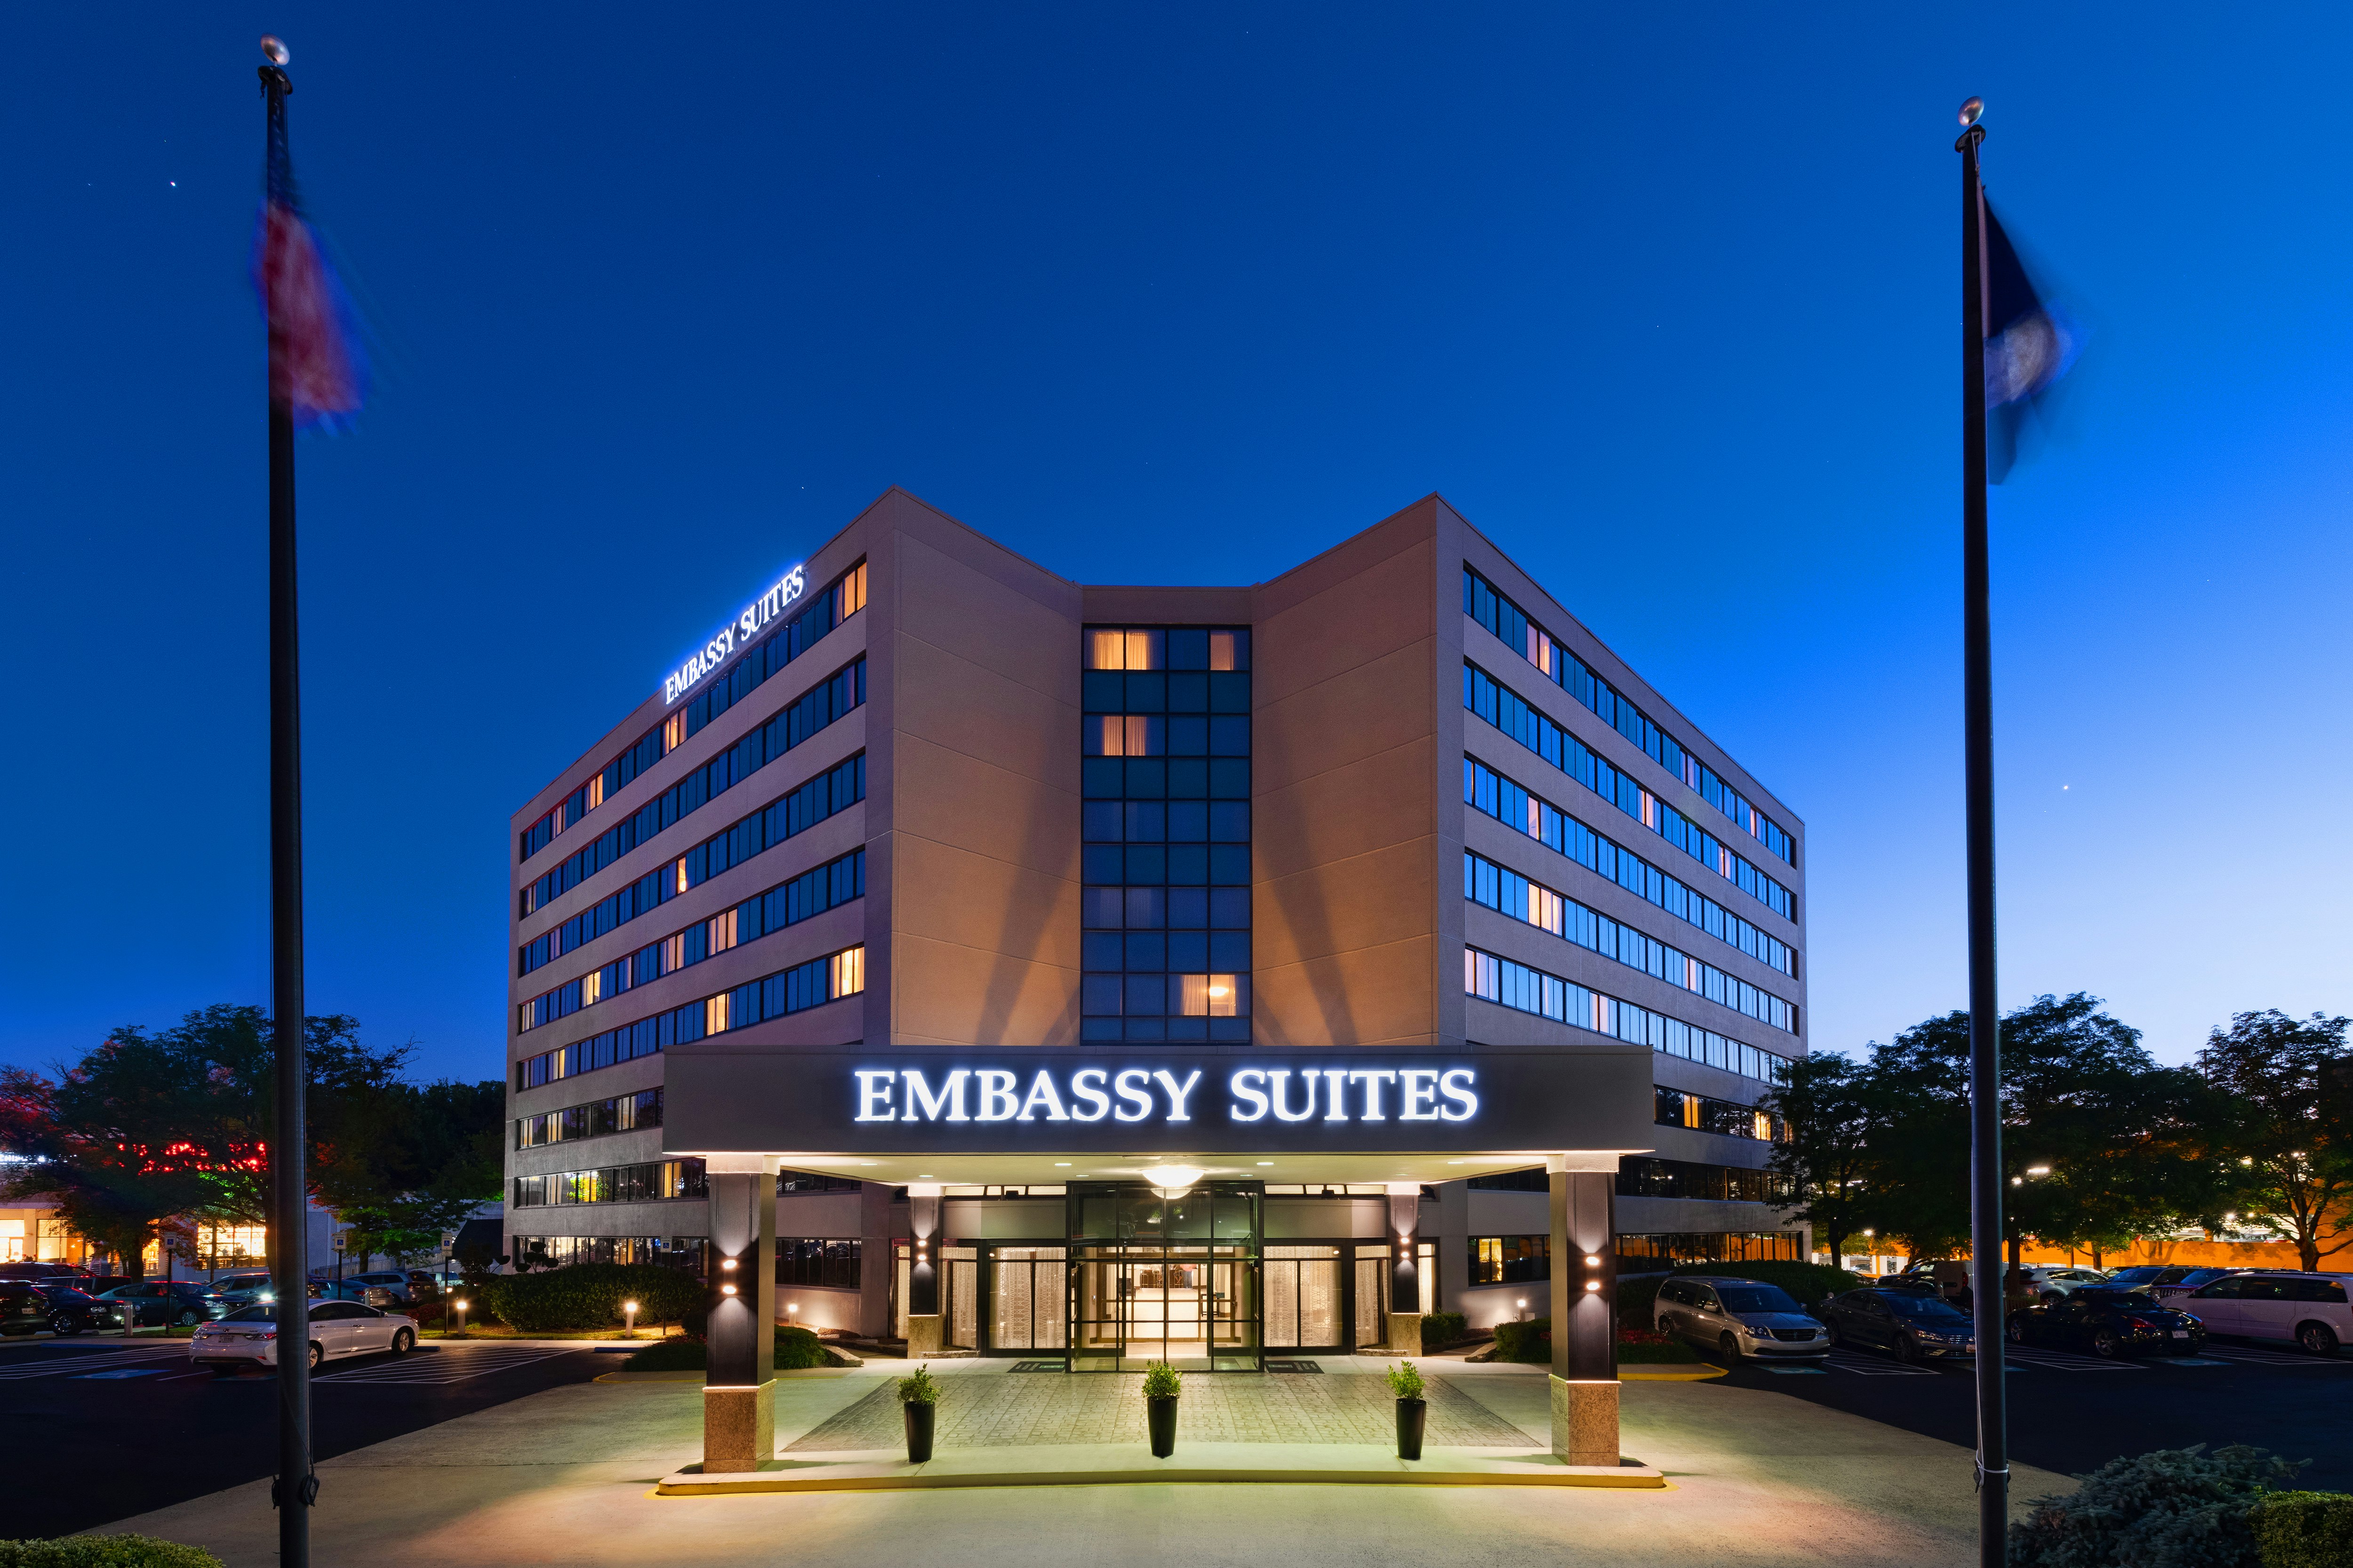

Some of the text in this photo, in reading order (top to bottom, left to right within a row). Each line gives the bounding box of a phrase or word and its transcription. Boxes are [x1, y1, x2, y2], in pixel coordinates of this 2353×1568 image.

[665, 565, 803, 704] EMBASSY SUITES
[854, 1069, 1478, 1122] EMBASSY SUITES
